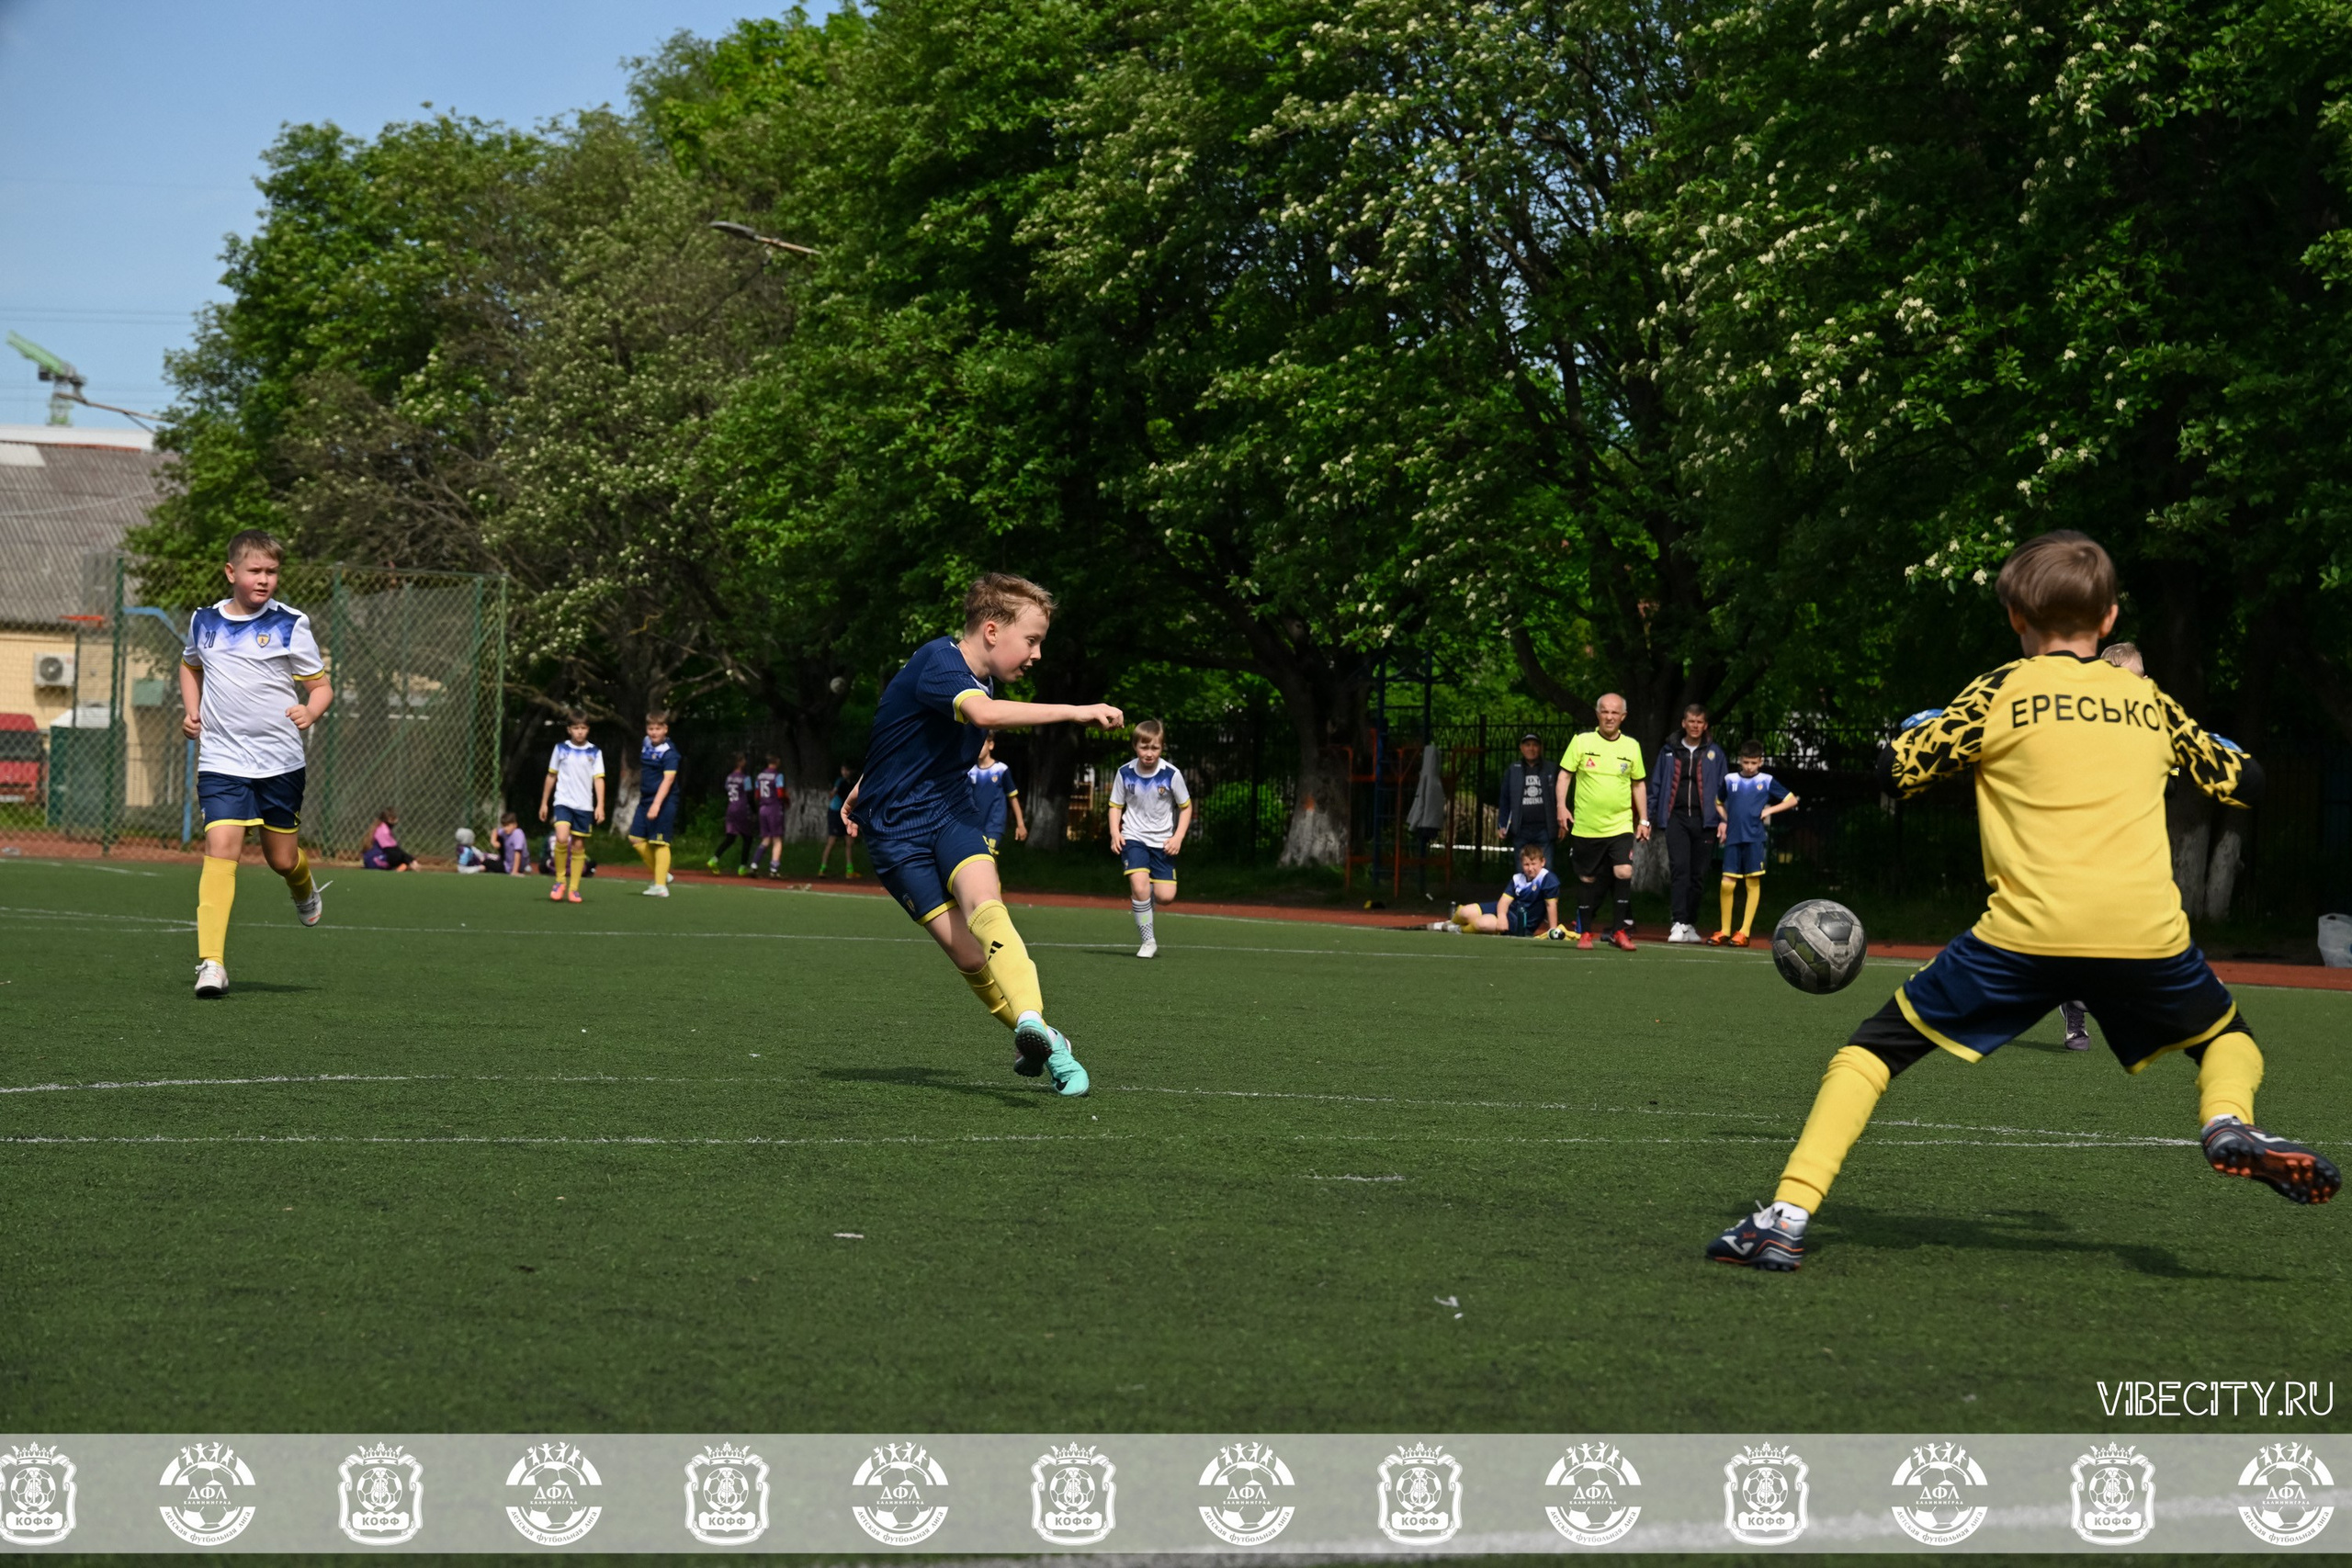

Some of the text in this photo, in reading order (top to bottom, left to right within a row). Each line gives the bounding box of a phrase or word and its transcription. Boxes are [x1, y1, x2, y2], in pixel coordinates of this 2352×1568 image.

[203, 630, 217, 649] 20
[2011, 694, 2160, 731] ЕРЕСЬКО
[760, 781, 770, 798] 15
